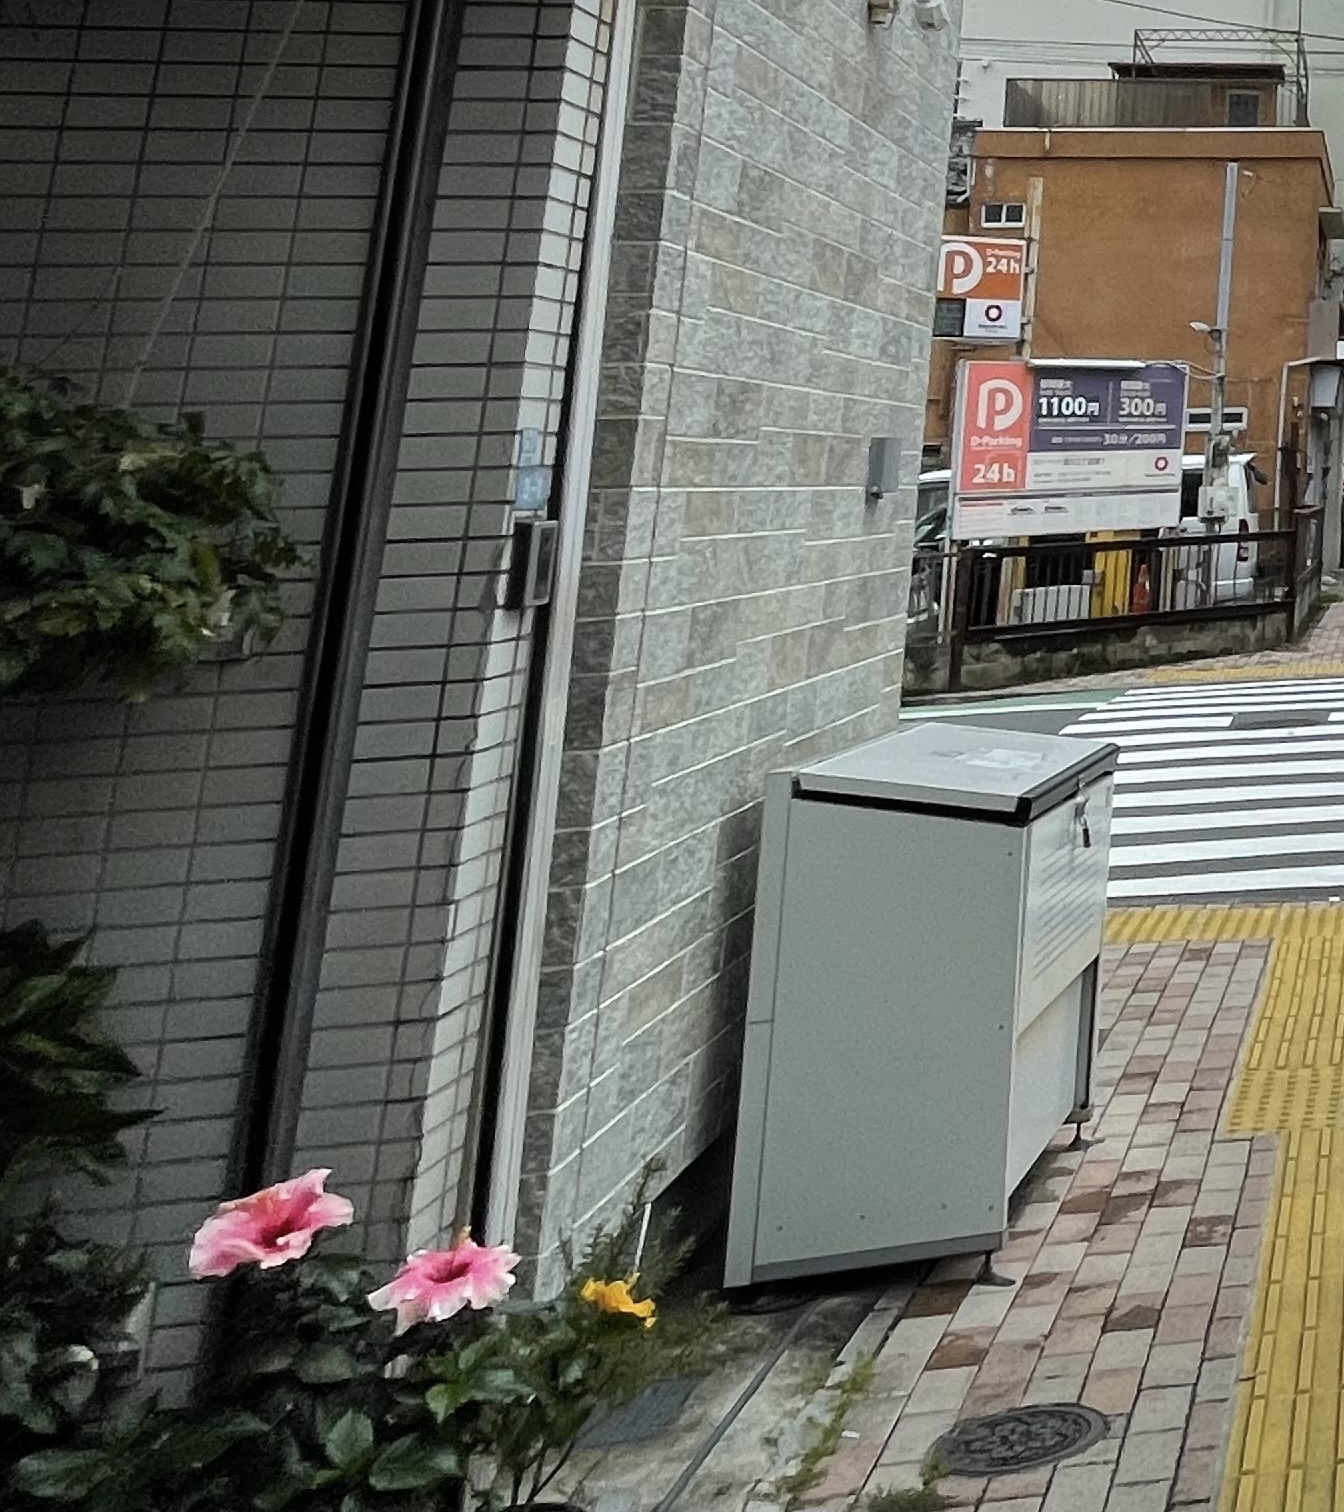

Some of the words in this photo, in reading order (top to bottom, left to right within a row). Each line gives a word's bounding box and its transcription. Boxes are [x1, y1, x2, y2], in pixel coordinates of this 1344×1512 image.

[937, 242, 983, 295] P
[985, 256, 1020, 274] 24h
[976, 379, 1023, 431] P
[1039, 396, 1099, 416] 1100円
[1118, 397, 1167, 416] 300円
[971, 463, 1015, 484] 24h
